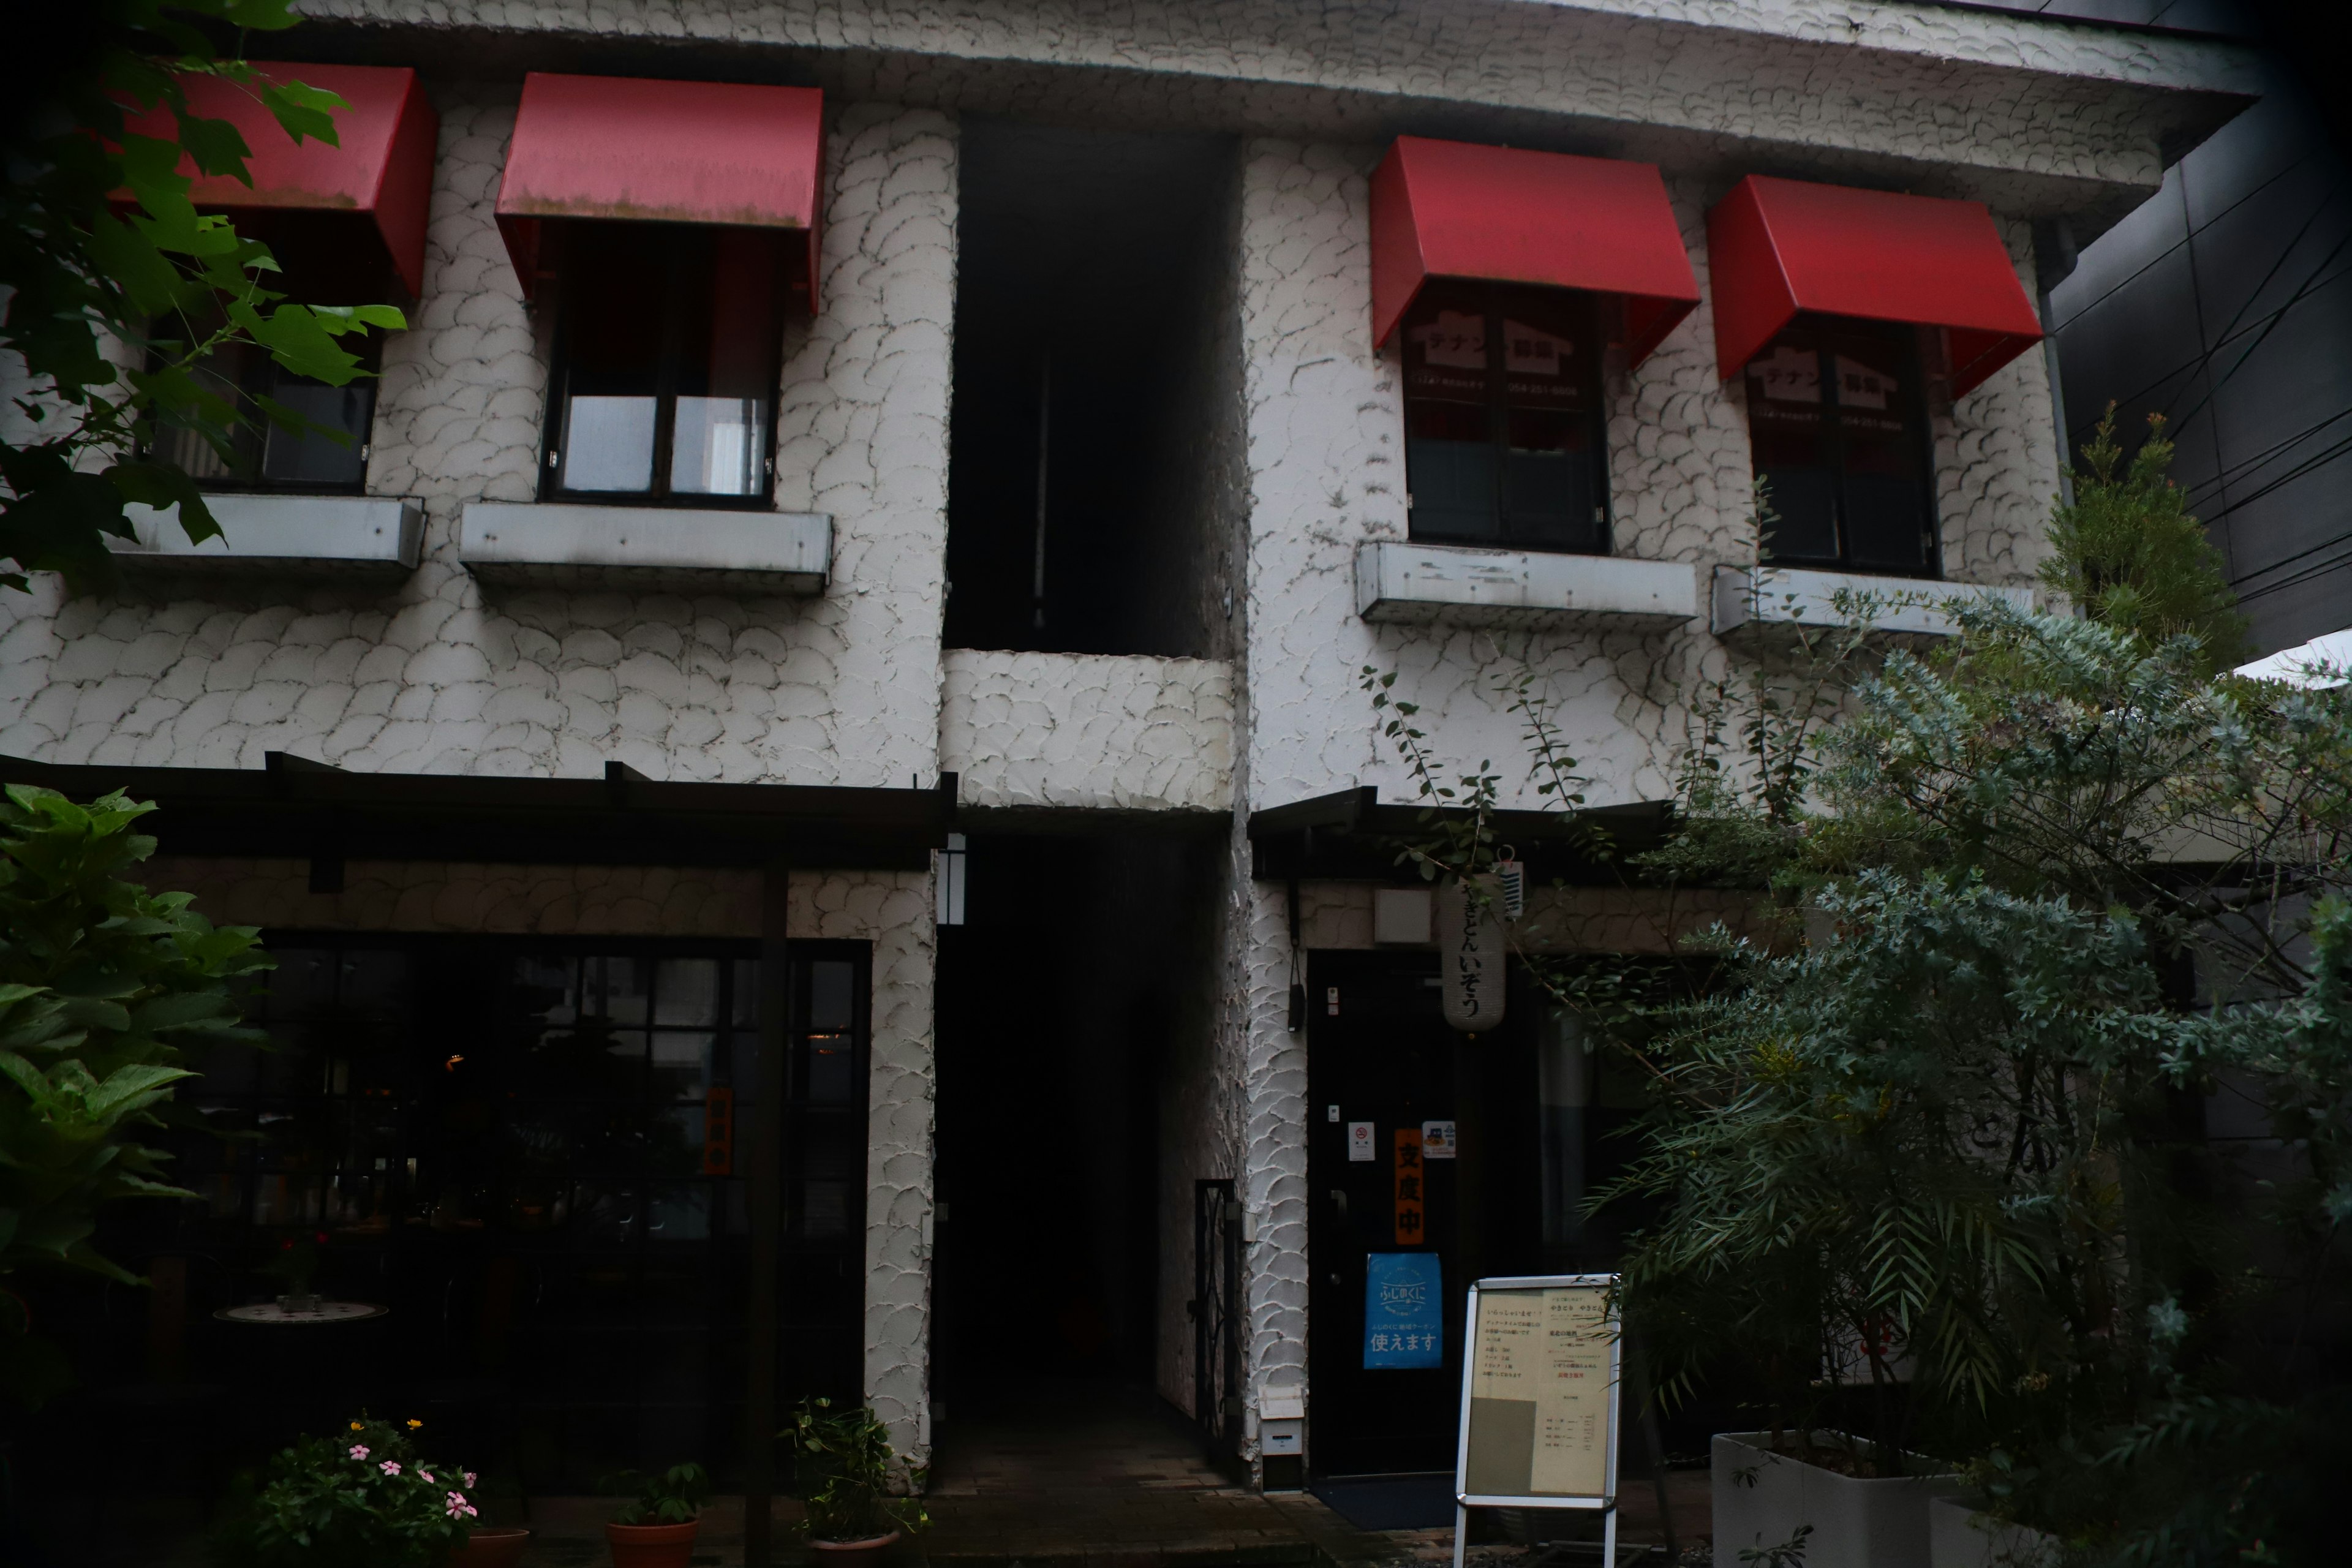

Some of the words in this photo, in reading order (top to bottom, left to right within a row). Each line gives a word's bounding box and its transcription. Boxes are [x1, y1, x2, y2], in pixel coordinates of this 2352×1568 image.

[1428, 332, 1555, 359] テナン募集
[1766, 368, 1881, 394] テナン募集
[1398, 1142, 1421, 1235] 支度中
[1380, 1286, 1426, 1301] ふじのくに
[1370, 1333, 1436, 1352] 使えます
